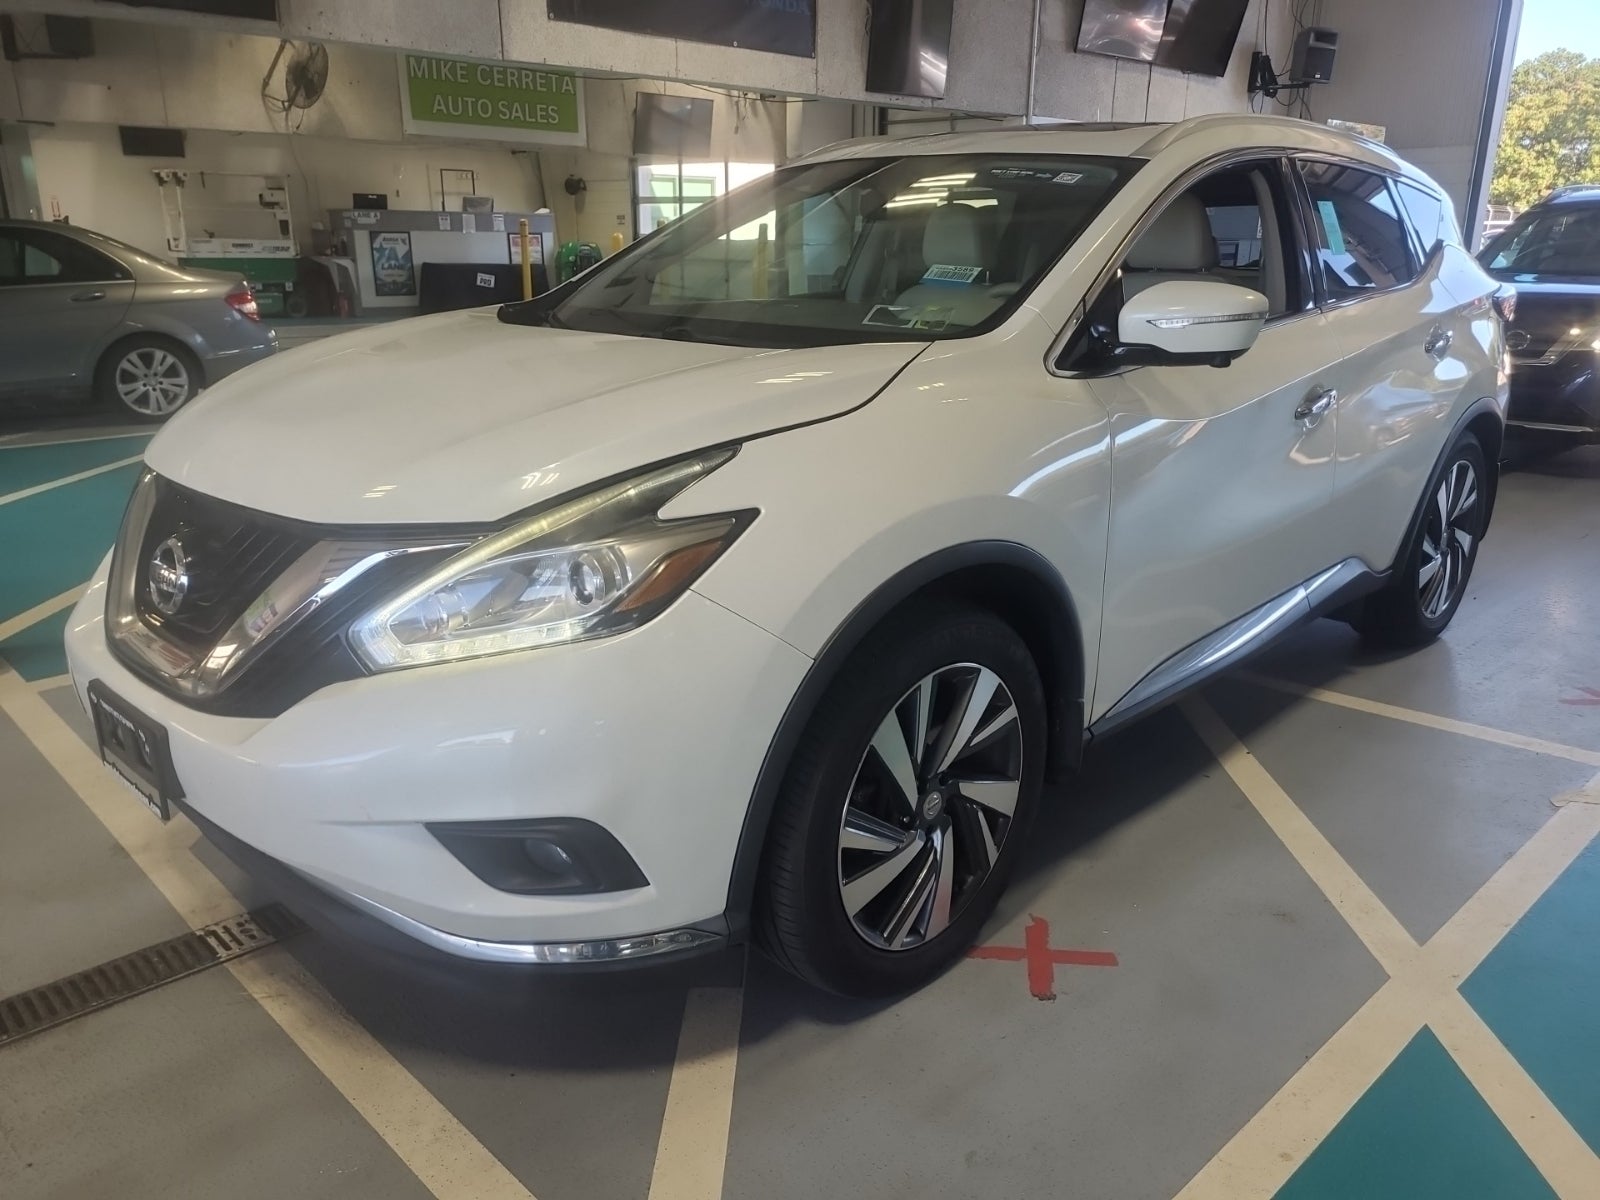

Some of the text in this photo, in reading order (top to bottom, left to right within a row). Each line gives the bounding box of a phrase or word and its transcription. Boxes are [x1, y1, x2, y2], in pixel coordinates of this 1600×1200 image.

[409, 56, 575, 94] MIKE CERRETA
[432, 94, 559, 124] AUTO SALES
